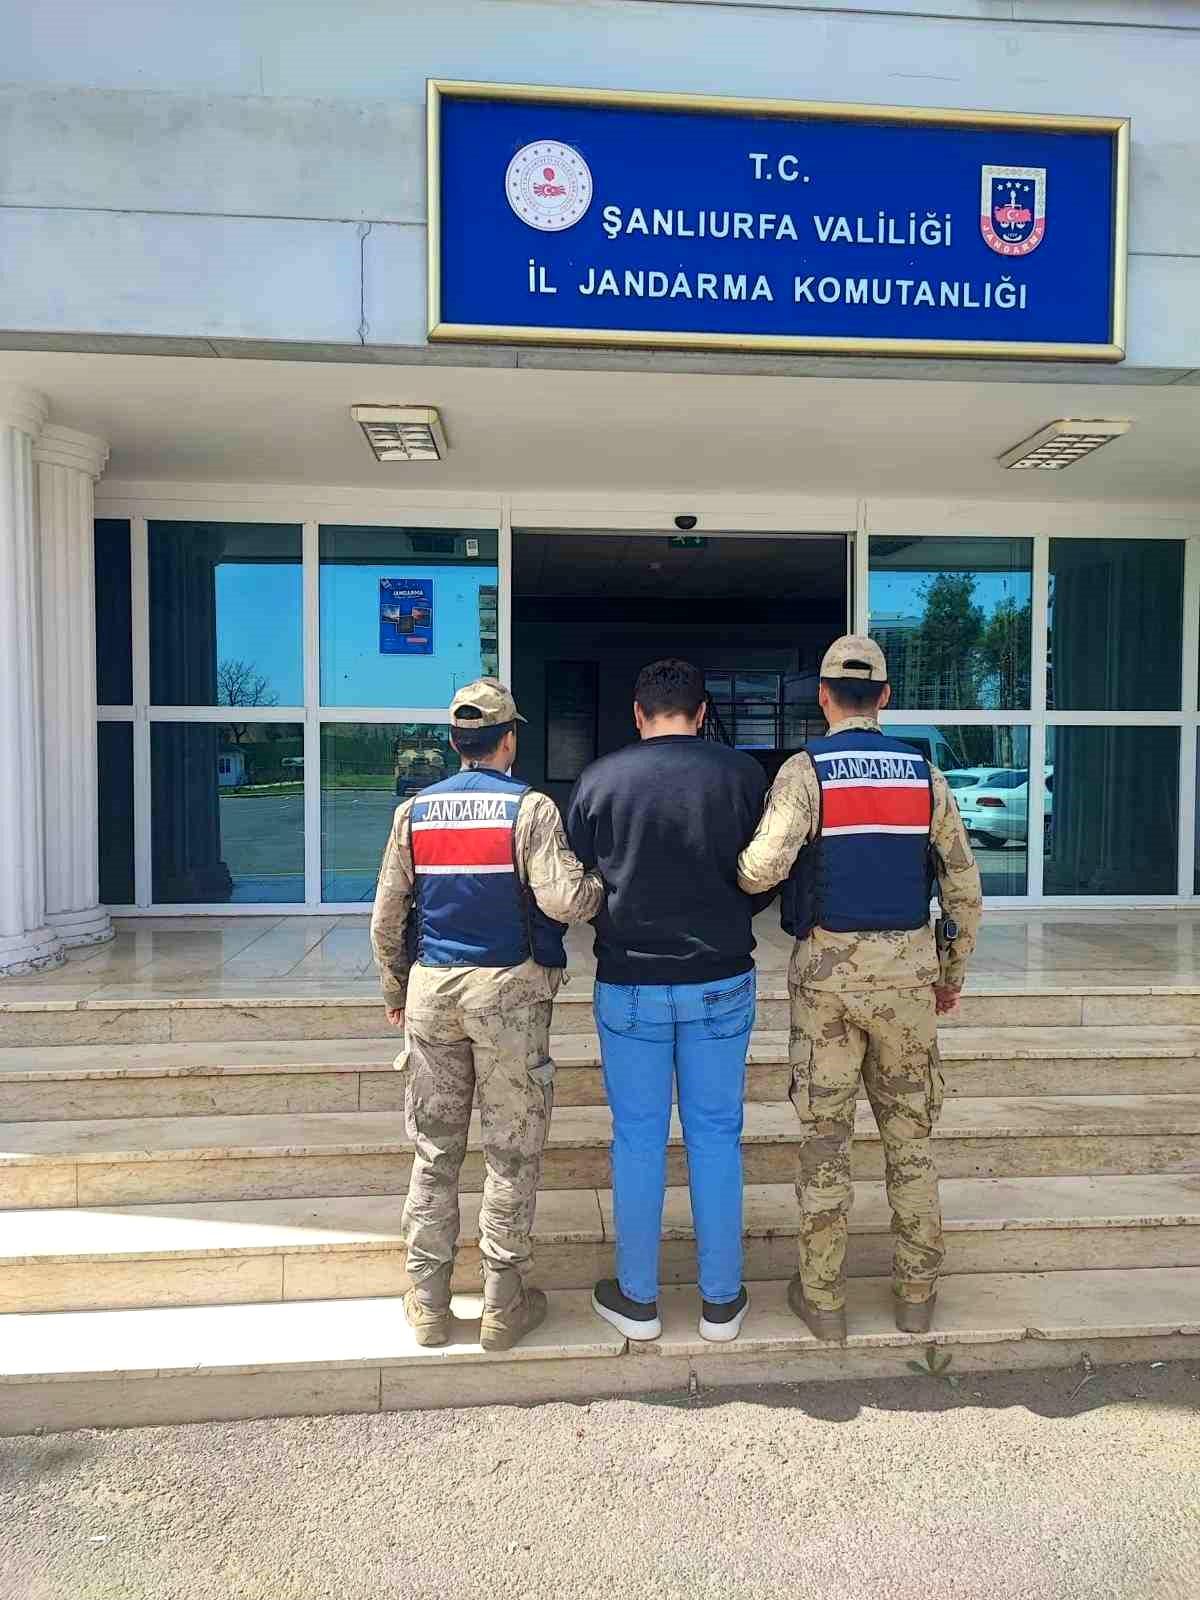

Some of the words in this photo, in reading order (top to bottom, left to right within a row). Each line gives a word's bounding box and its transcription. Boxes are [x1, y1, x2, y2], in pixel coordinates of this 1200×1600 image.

[749, 153, 811, 183] T.C.
[602, 206, 799, 241] ŞANLIURFA
[813, 212, 952, 247] VALİLİĞİ
[528, 259, 557, 294] İL
[579, 268, 774, 302] JANDARMA
[794, 275, 1027, 310] KOMUTANLIĞI
[827, 758, 918, 779] JANDARMA
[422, 800, 507, 821] JANDARMA
